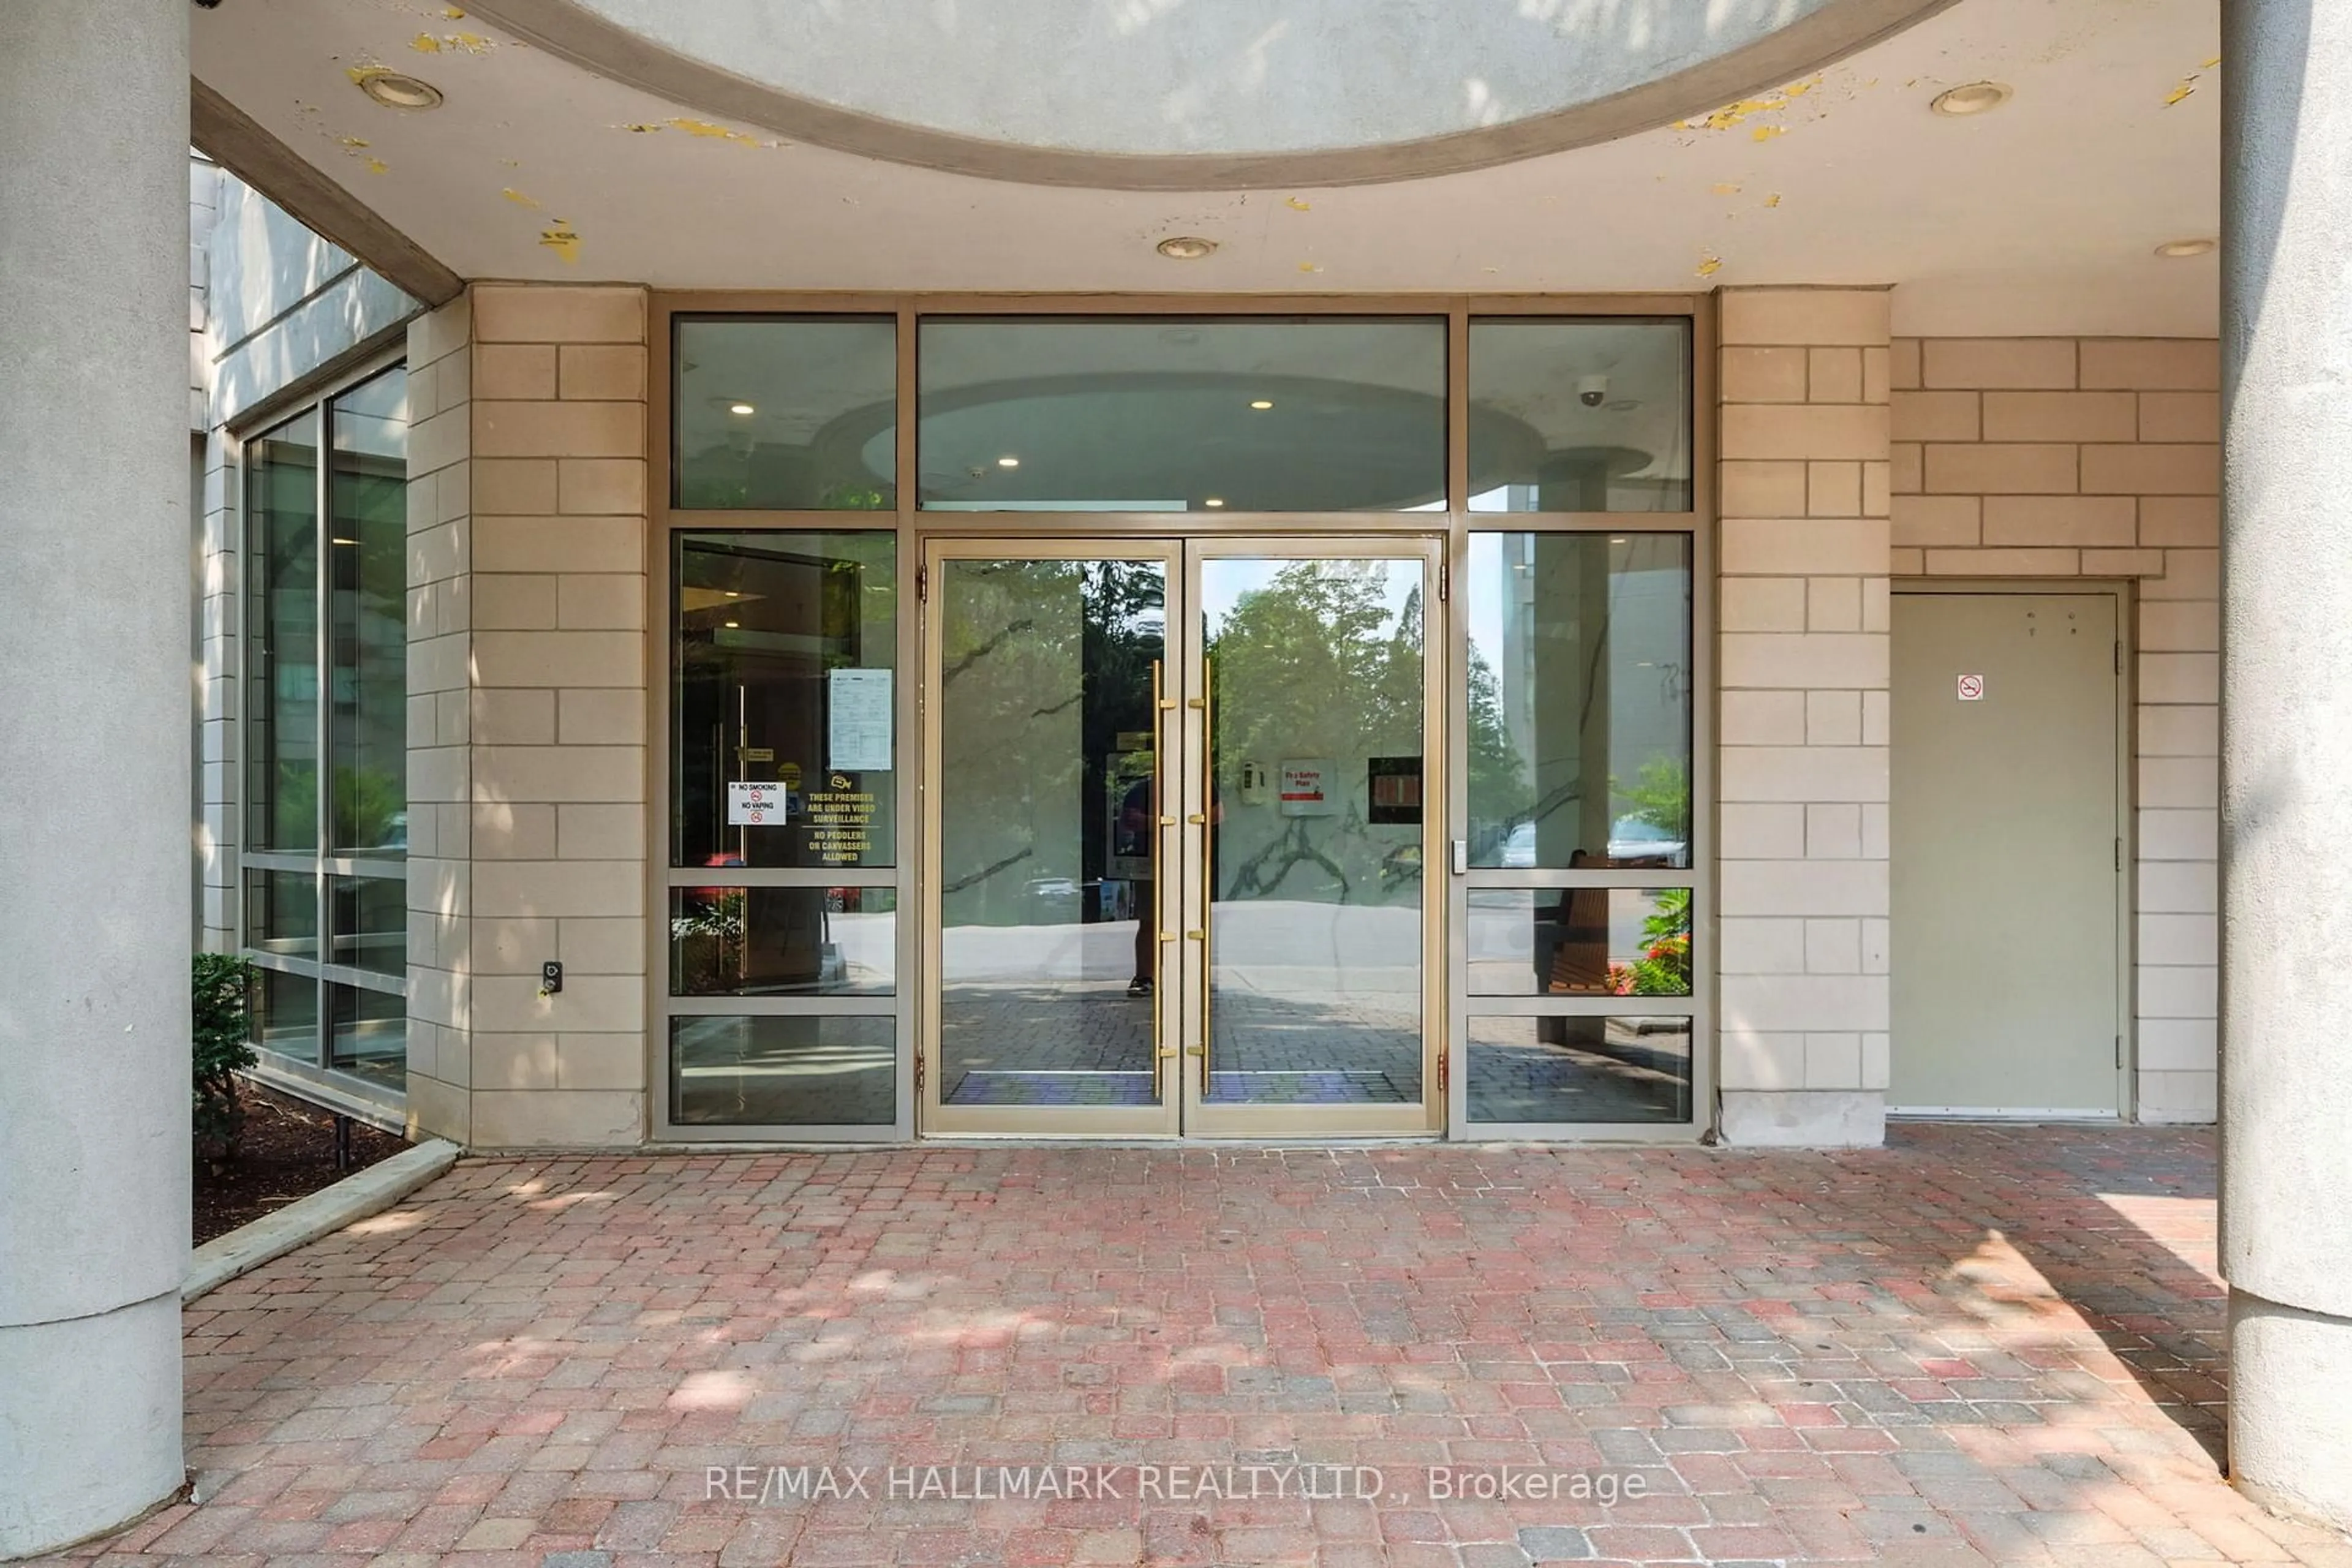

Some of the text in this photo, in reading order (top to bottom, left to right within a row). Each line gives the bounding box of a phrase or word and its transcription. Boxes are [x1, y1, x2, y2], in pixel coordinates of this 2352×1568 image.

[809, 793, 873, 802] THESE PREMISES
[807, 804, 875, 812] ARE UNDER VIDEO
[813, 815, 869, 823] SURVEILLANCE
[814, 831, 866, 840] NO PEDDLERS
[809, 842, 870, 850] OR CANVASSERS
[822, 852, 858, 861] ALLOWED
